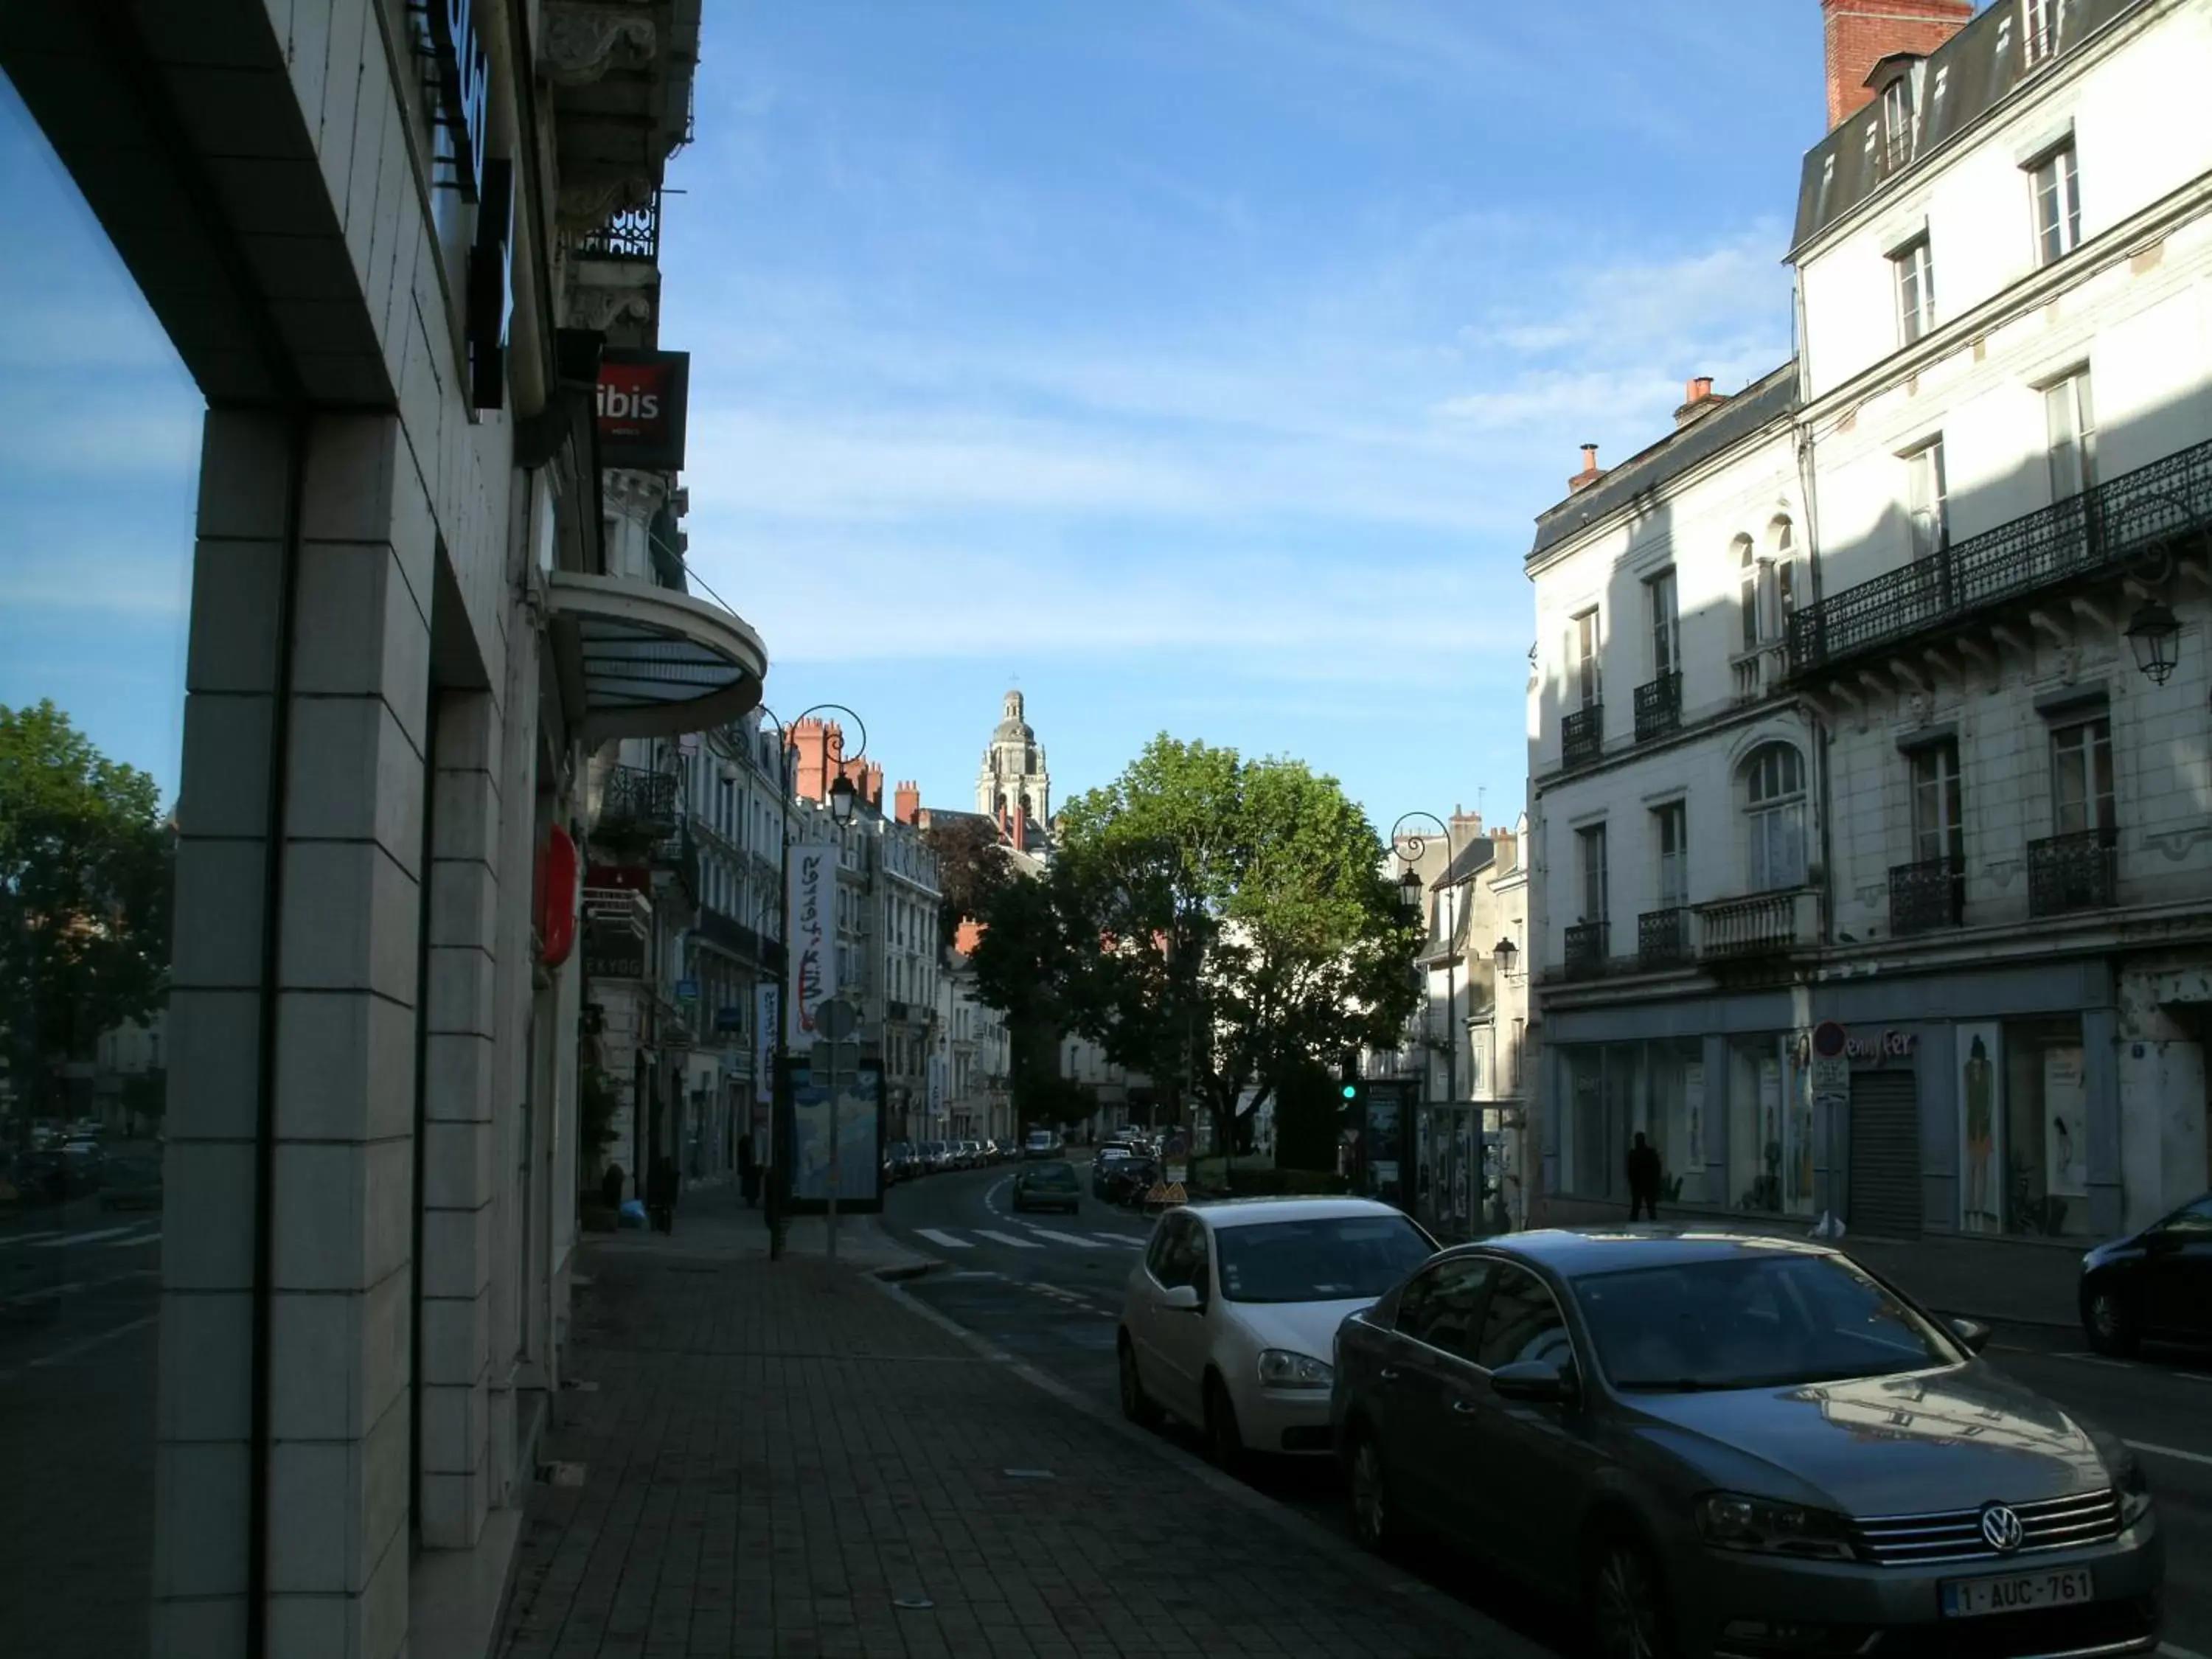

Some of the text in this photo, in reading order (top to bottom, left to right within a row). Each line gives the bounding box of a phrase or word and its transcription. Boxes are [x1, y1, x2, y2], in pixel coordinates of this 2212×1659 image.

[597, 383, 658, 420] ibis
[585, 957, 641, 975] EKYOG
[1961, 1573, 2087, 1610] 1-AUC-761
